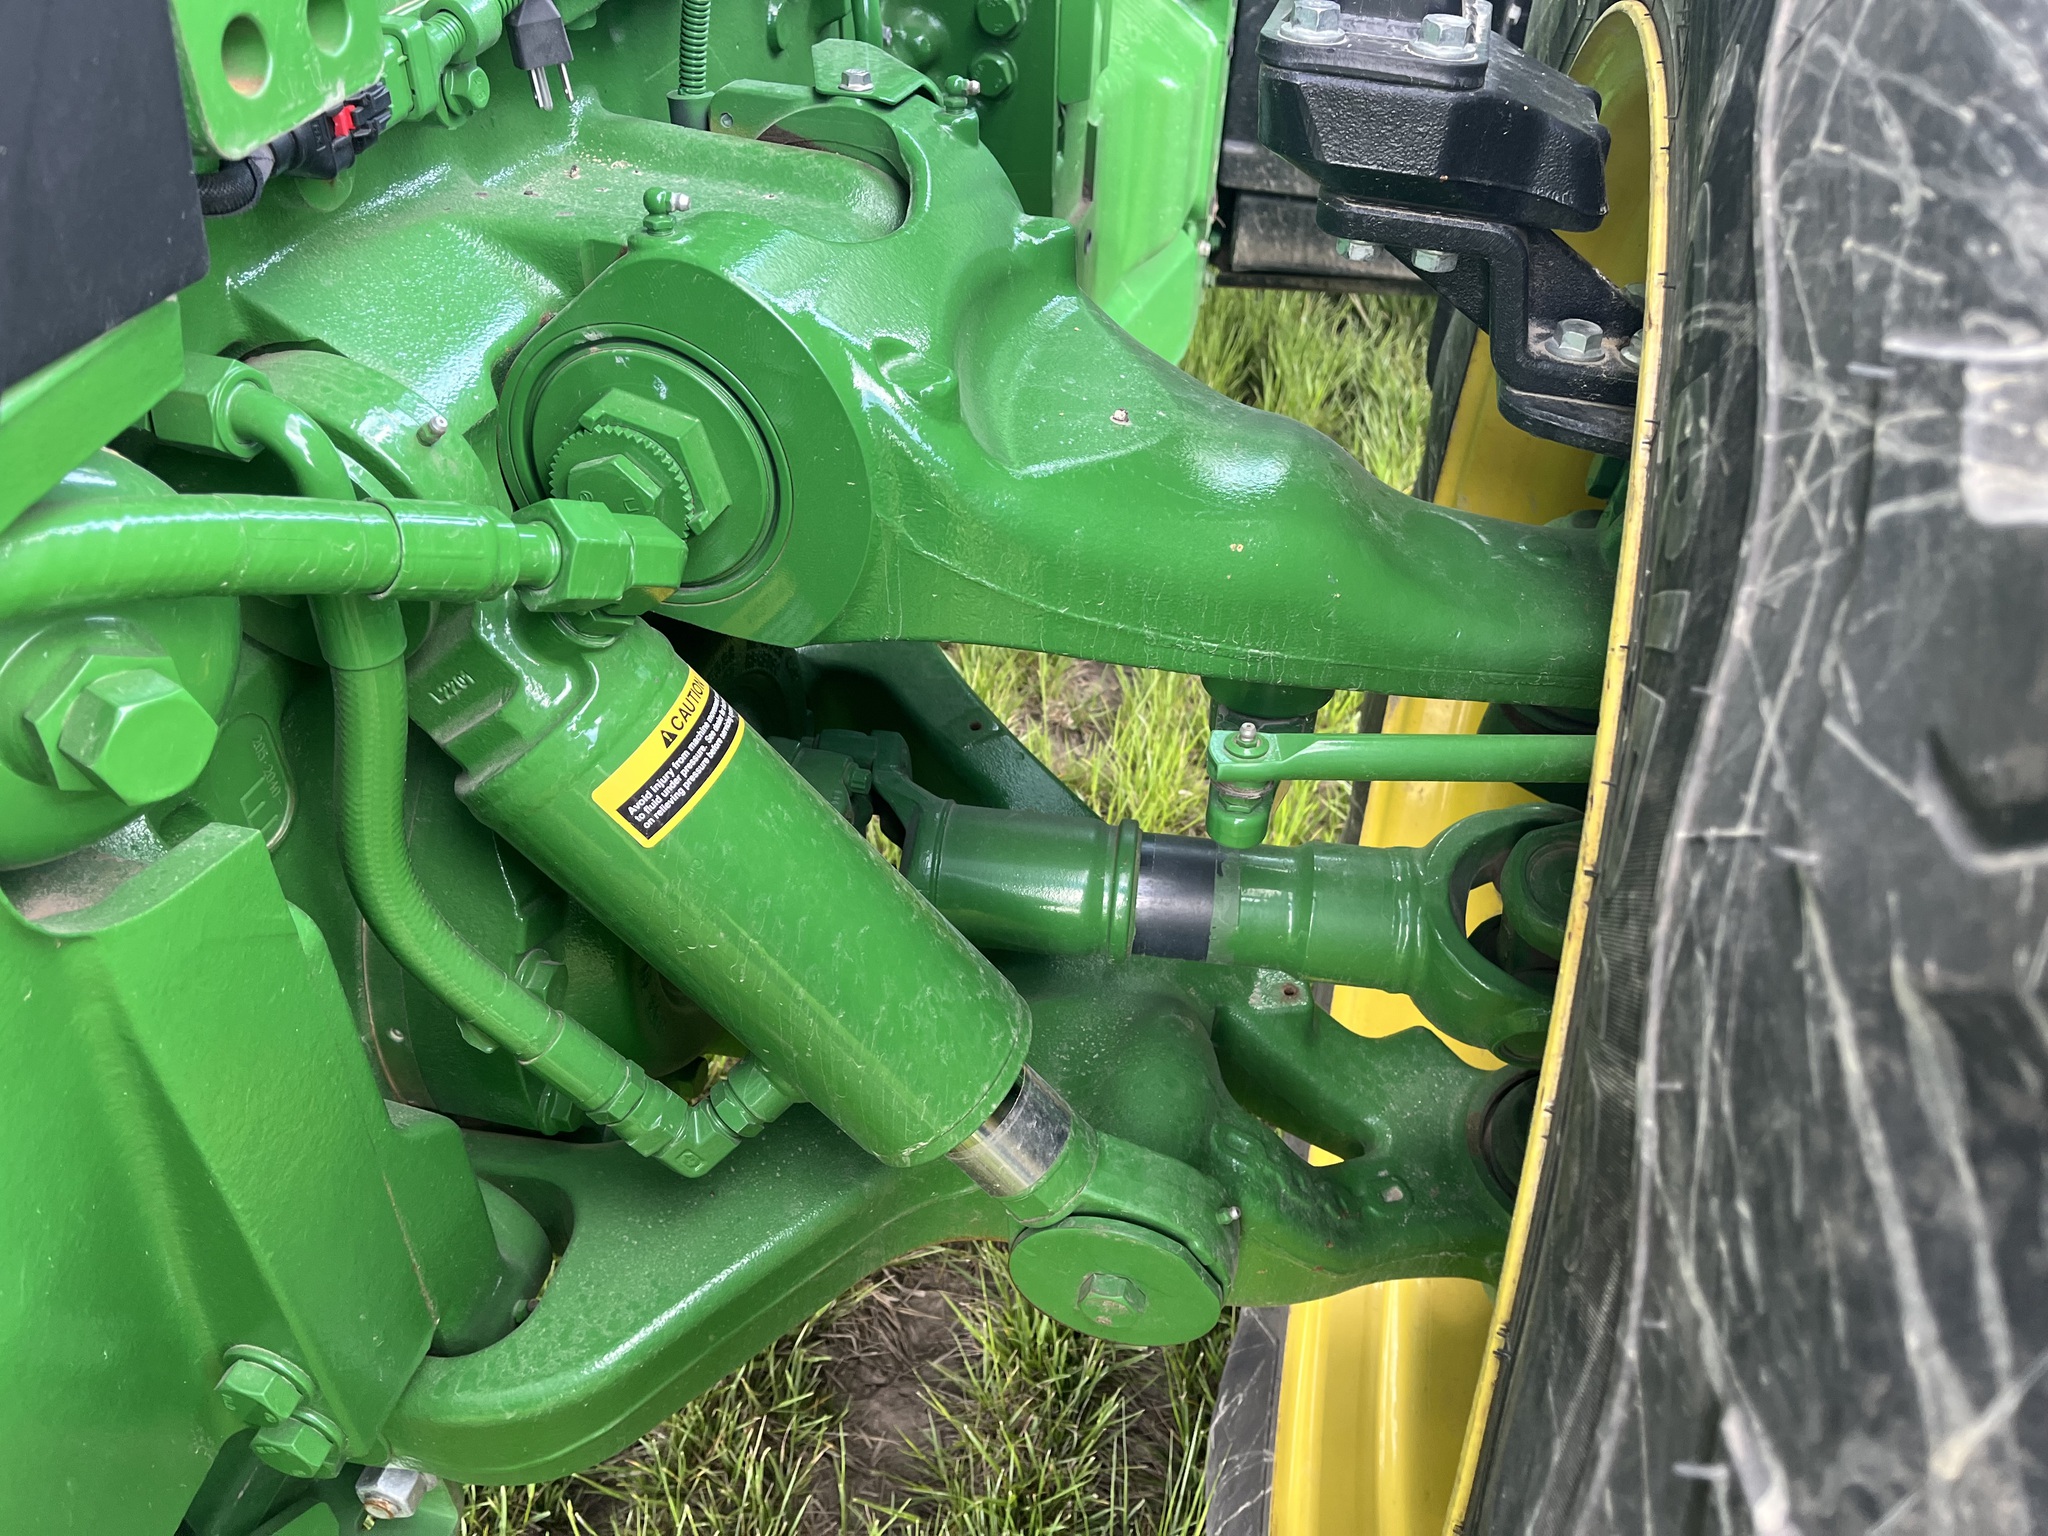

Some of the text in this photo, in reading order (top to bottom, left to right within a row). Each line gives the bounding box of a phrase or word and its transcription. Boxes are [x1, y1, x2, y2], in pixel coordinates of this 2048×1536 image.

[671, 676, 705, 731] CAUTION
[628, 790, 653, 815] Avoid
[650, 768, 675, 793] injury
[672, 750, 691, 770] from
[688, 722, 710, 751] machine
[634, 812, 646, 822] to
[643, 795, 663, 814] fluid
[661, 774, 682, 798] under
[680, 745, 708, 778] pressure.
[705, 730, 716, 743] See
[643, 817, 656, 829] on
[654, 787, 686, 819] relieving
[683, 757, 710, 791] pressure
[706, 737, 723, 759] before
